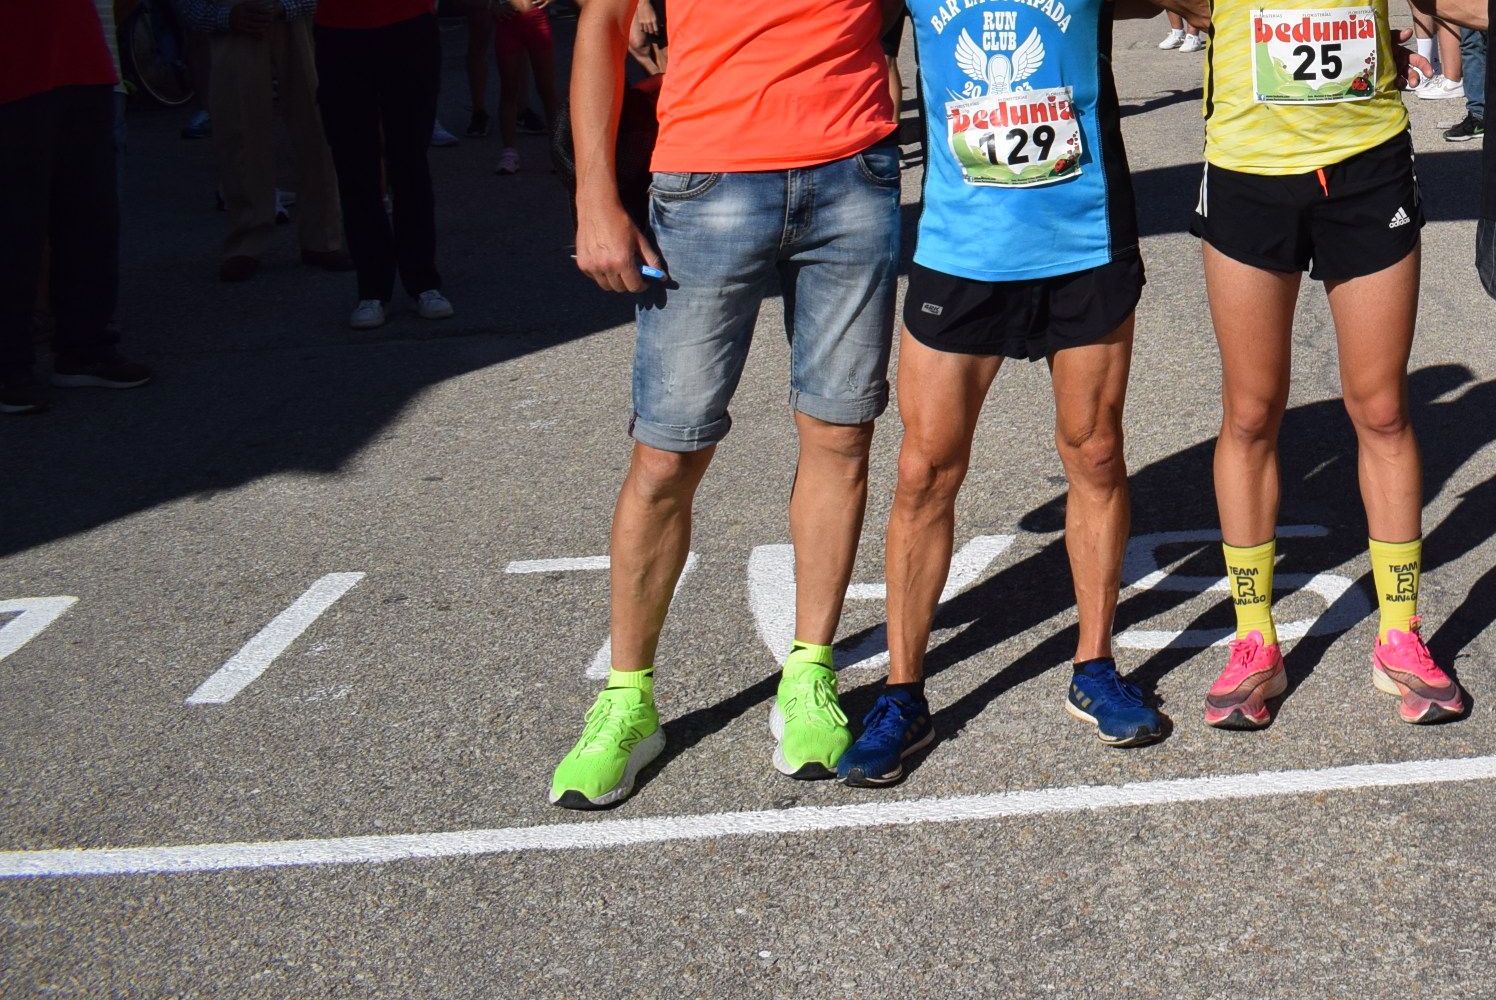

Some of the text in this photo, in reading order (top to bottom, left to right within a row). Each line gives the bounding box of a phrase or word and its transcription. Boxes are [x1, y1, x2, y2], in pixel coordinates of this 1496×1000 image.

[982, 11, 1018, 31] RUN
[1254, 15, 1375, 44] bedunia
[982, 31, 1018, 51] CLUB
[1292, 43, 1343, 81] 25
[951, 96, 1076, 135] bedunia
[978, 125, 1056, 166] 129
[1228, 566, 1259, 576] TEAM
[1388, 561, 1418, 573] TEAM
[1386, 594, 1418, 603] RUN&G
